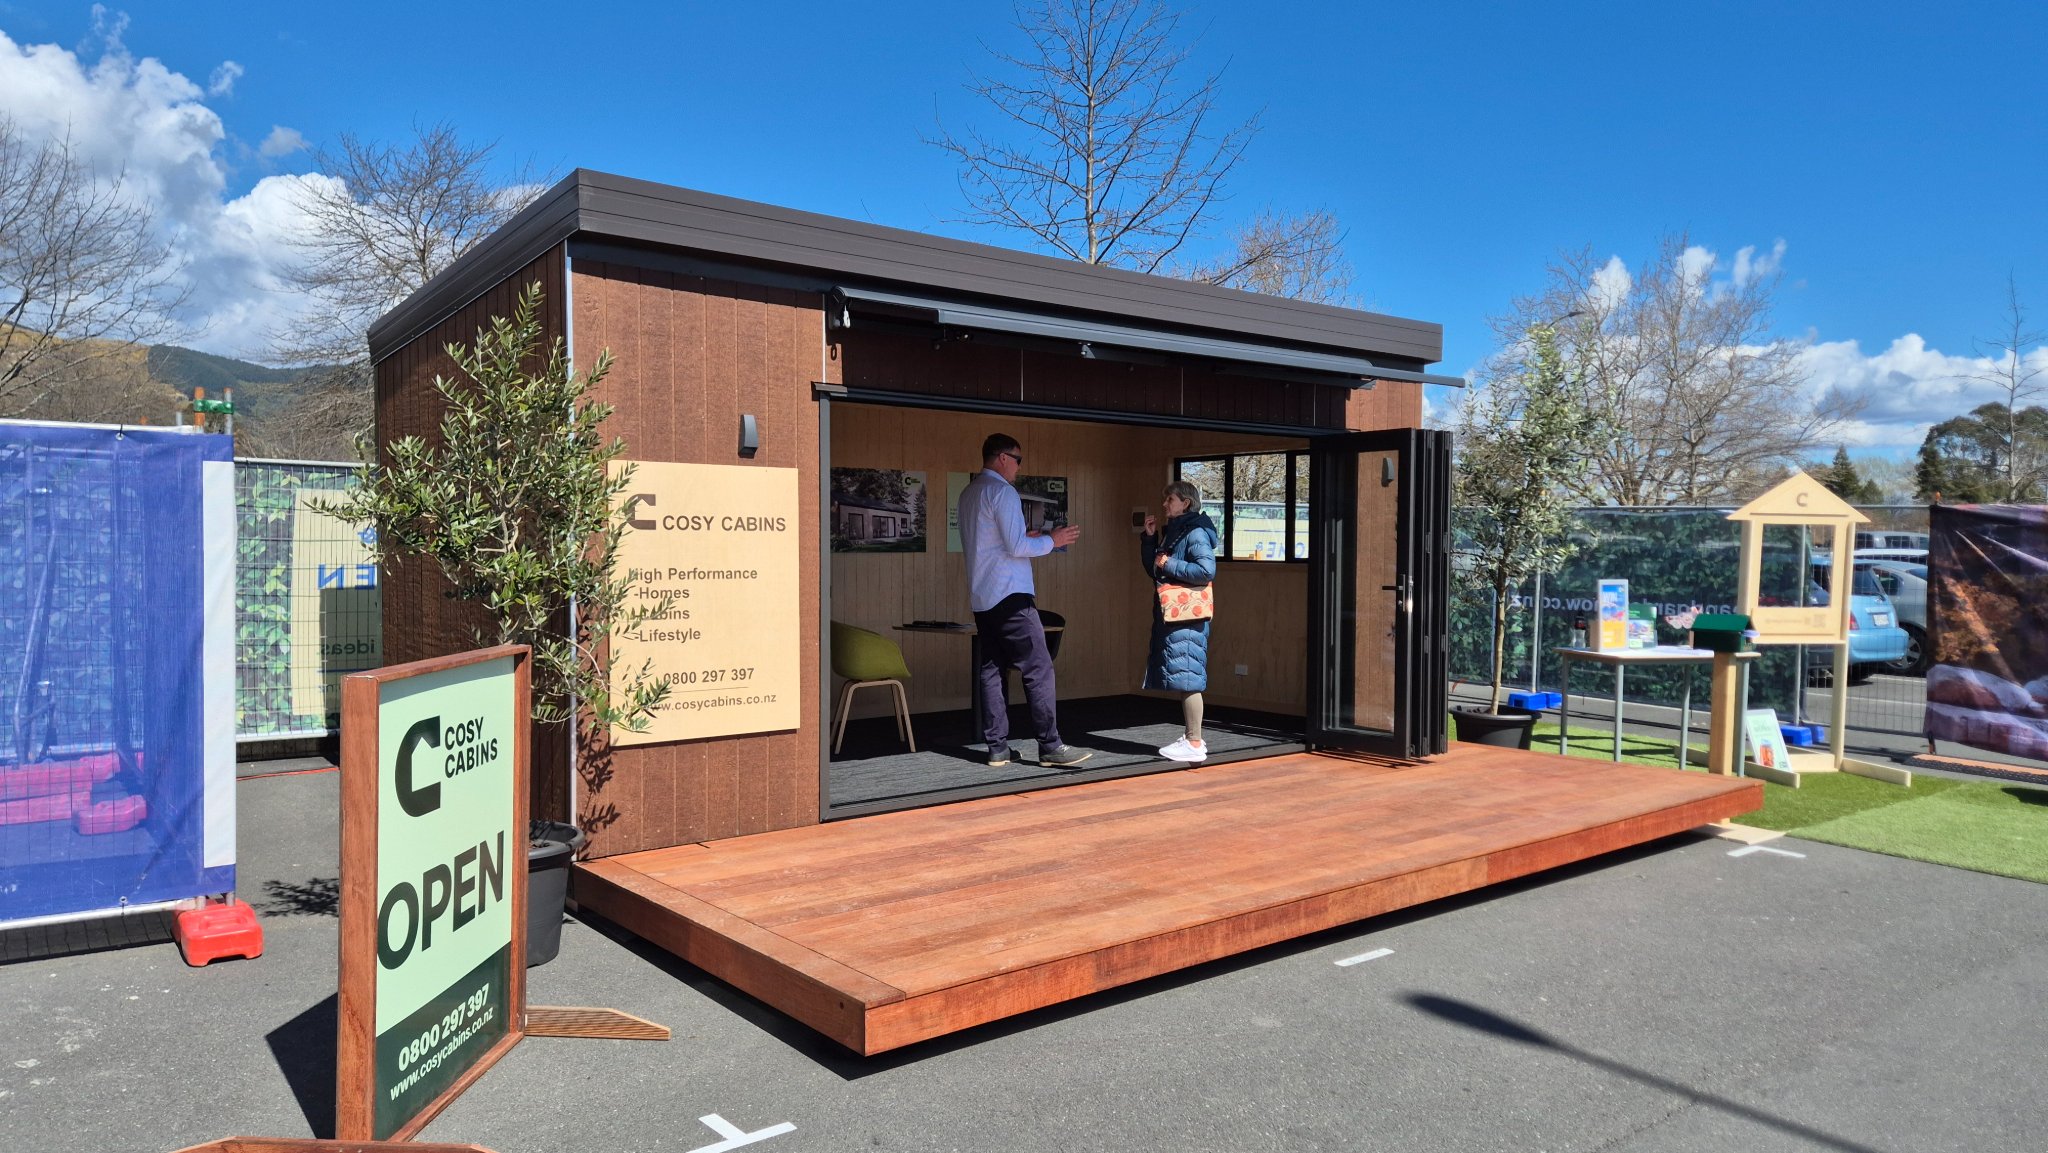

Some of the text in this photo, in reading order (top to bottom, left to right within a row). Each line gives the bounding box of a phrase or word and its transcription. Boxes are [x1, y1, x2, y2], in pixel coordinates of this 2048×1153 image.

[1796, 493, 1808, 507] C
[662, 515, 714, 531] COSY
[721, 516, 786, 532] CABINS
[668, 567, 758, 581] Performance
[634, 586, 690, 599] -Homes
[634, 604, 690, 620] -bins
[634, 628, 701, 643] -Lifestyle
[663, 667, 755, 685] 0800 297 397
[642, 694, 776, 712] ww.cosycabins.co.nz
[395, 715, 484, 818] C COSY
[445, 738, 498, 779] CABINS
[377, 830, 505, 970] OPEN
[398, 982, 490, 1072] 0800 297 397
[390, 1006, 494, 1101] www.cosycabins.co.nz
